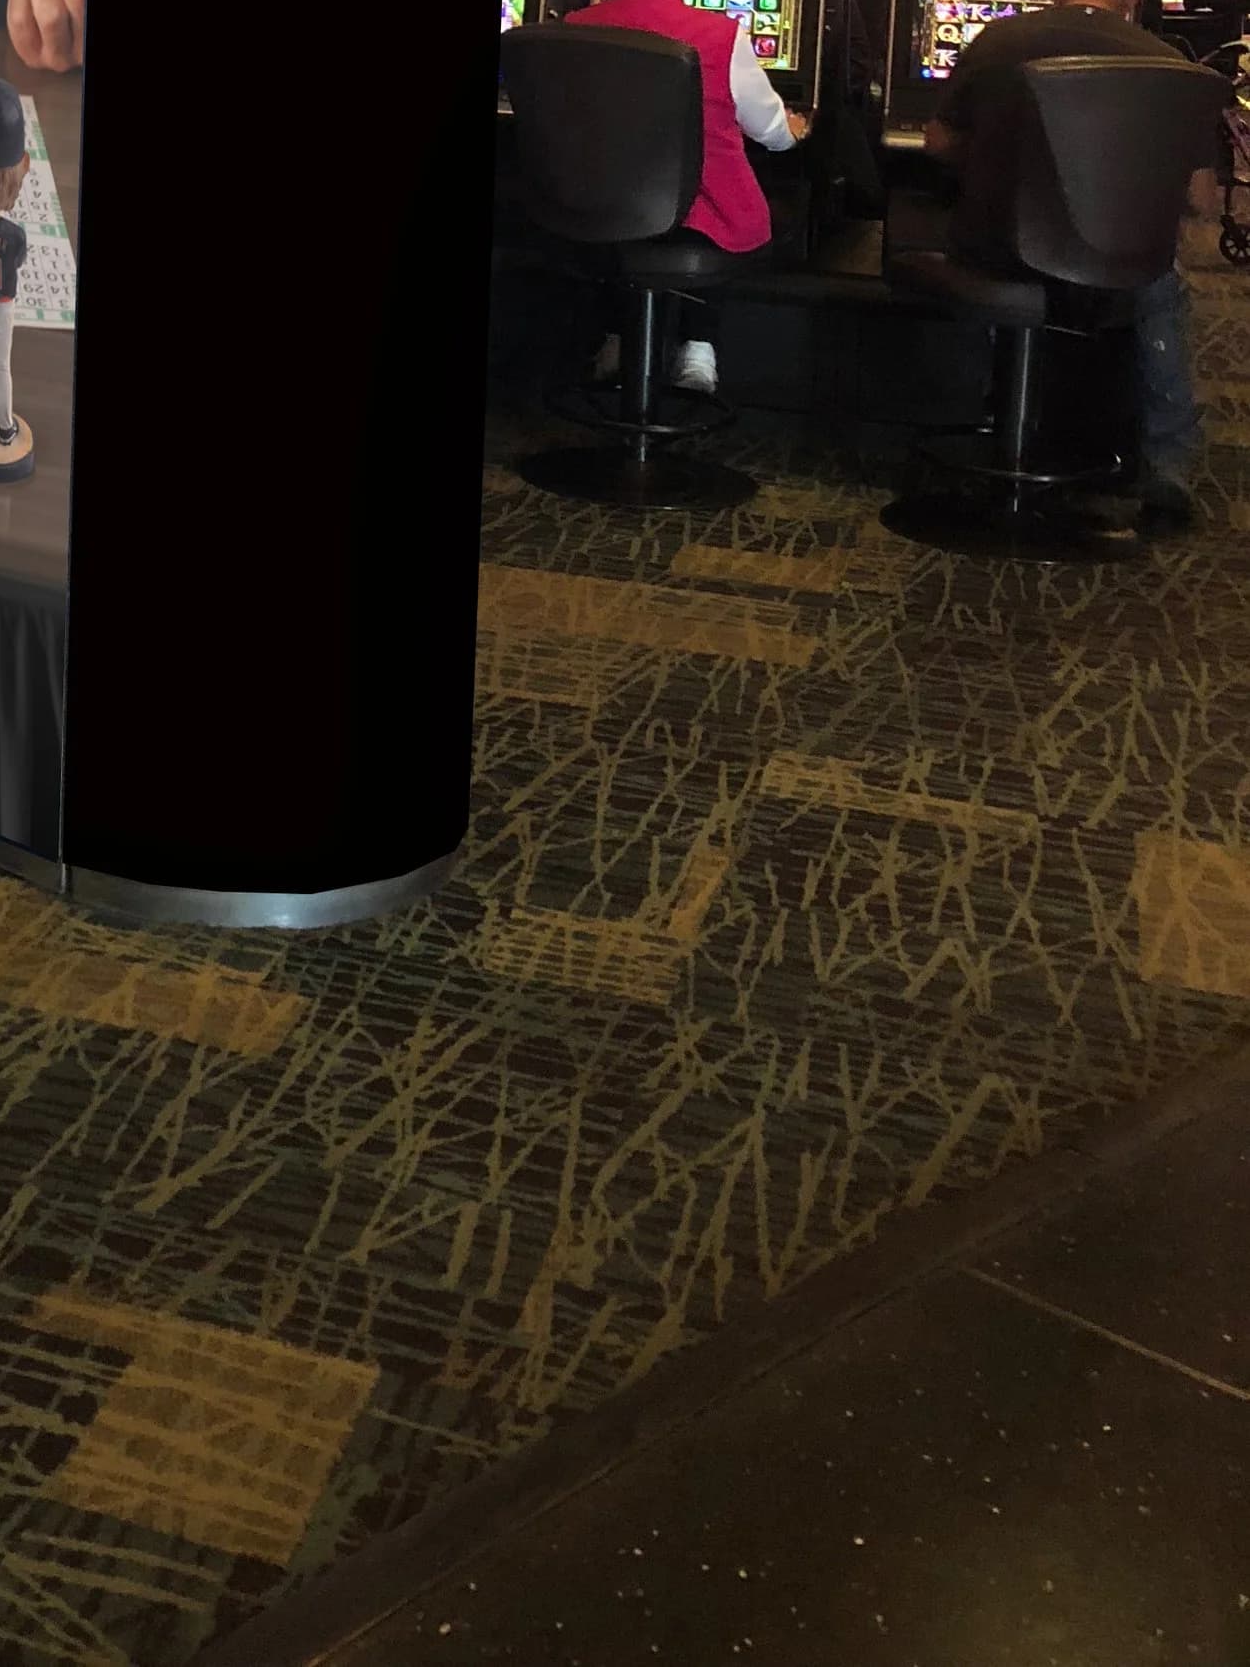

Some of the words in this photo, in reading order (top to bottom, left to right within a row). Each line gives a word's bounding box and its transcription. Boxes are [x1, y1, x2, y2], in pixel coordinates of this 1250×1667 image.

[937, 24, 962, 44] Q
[41, 246, 58, 256] 13
[21, 269, 38, 280] 19
[47, 272, 66, 282] 10
[23, 284, 44, 294] 29
[50, 285, 69, 294] 14
[26, 298, 46, 306] 30
[60, 300, 68, 308] 3
